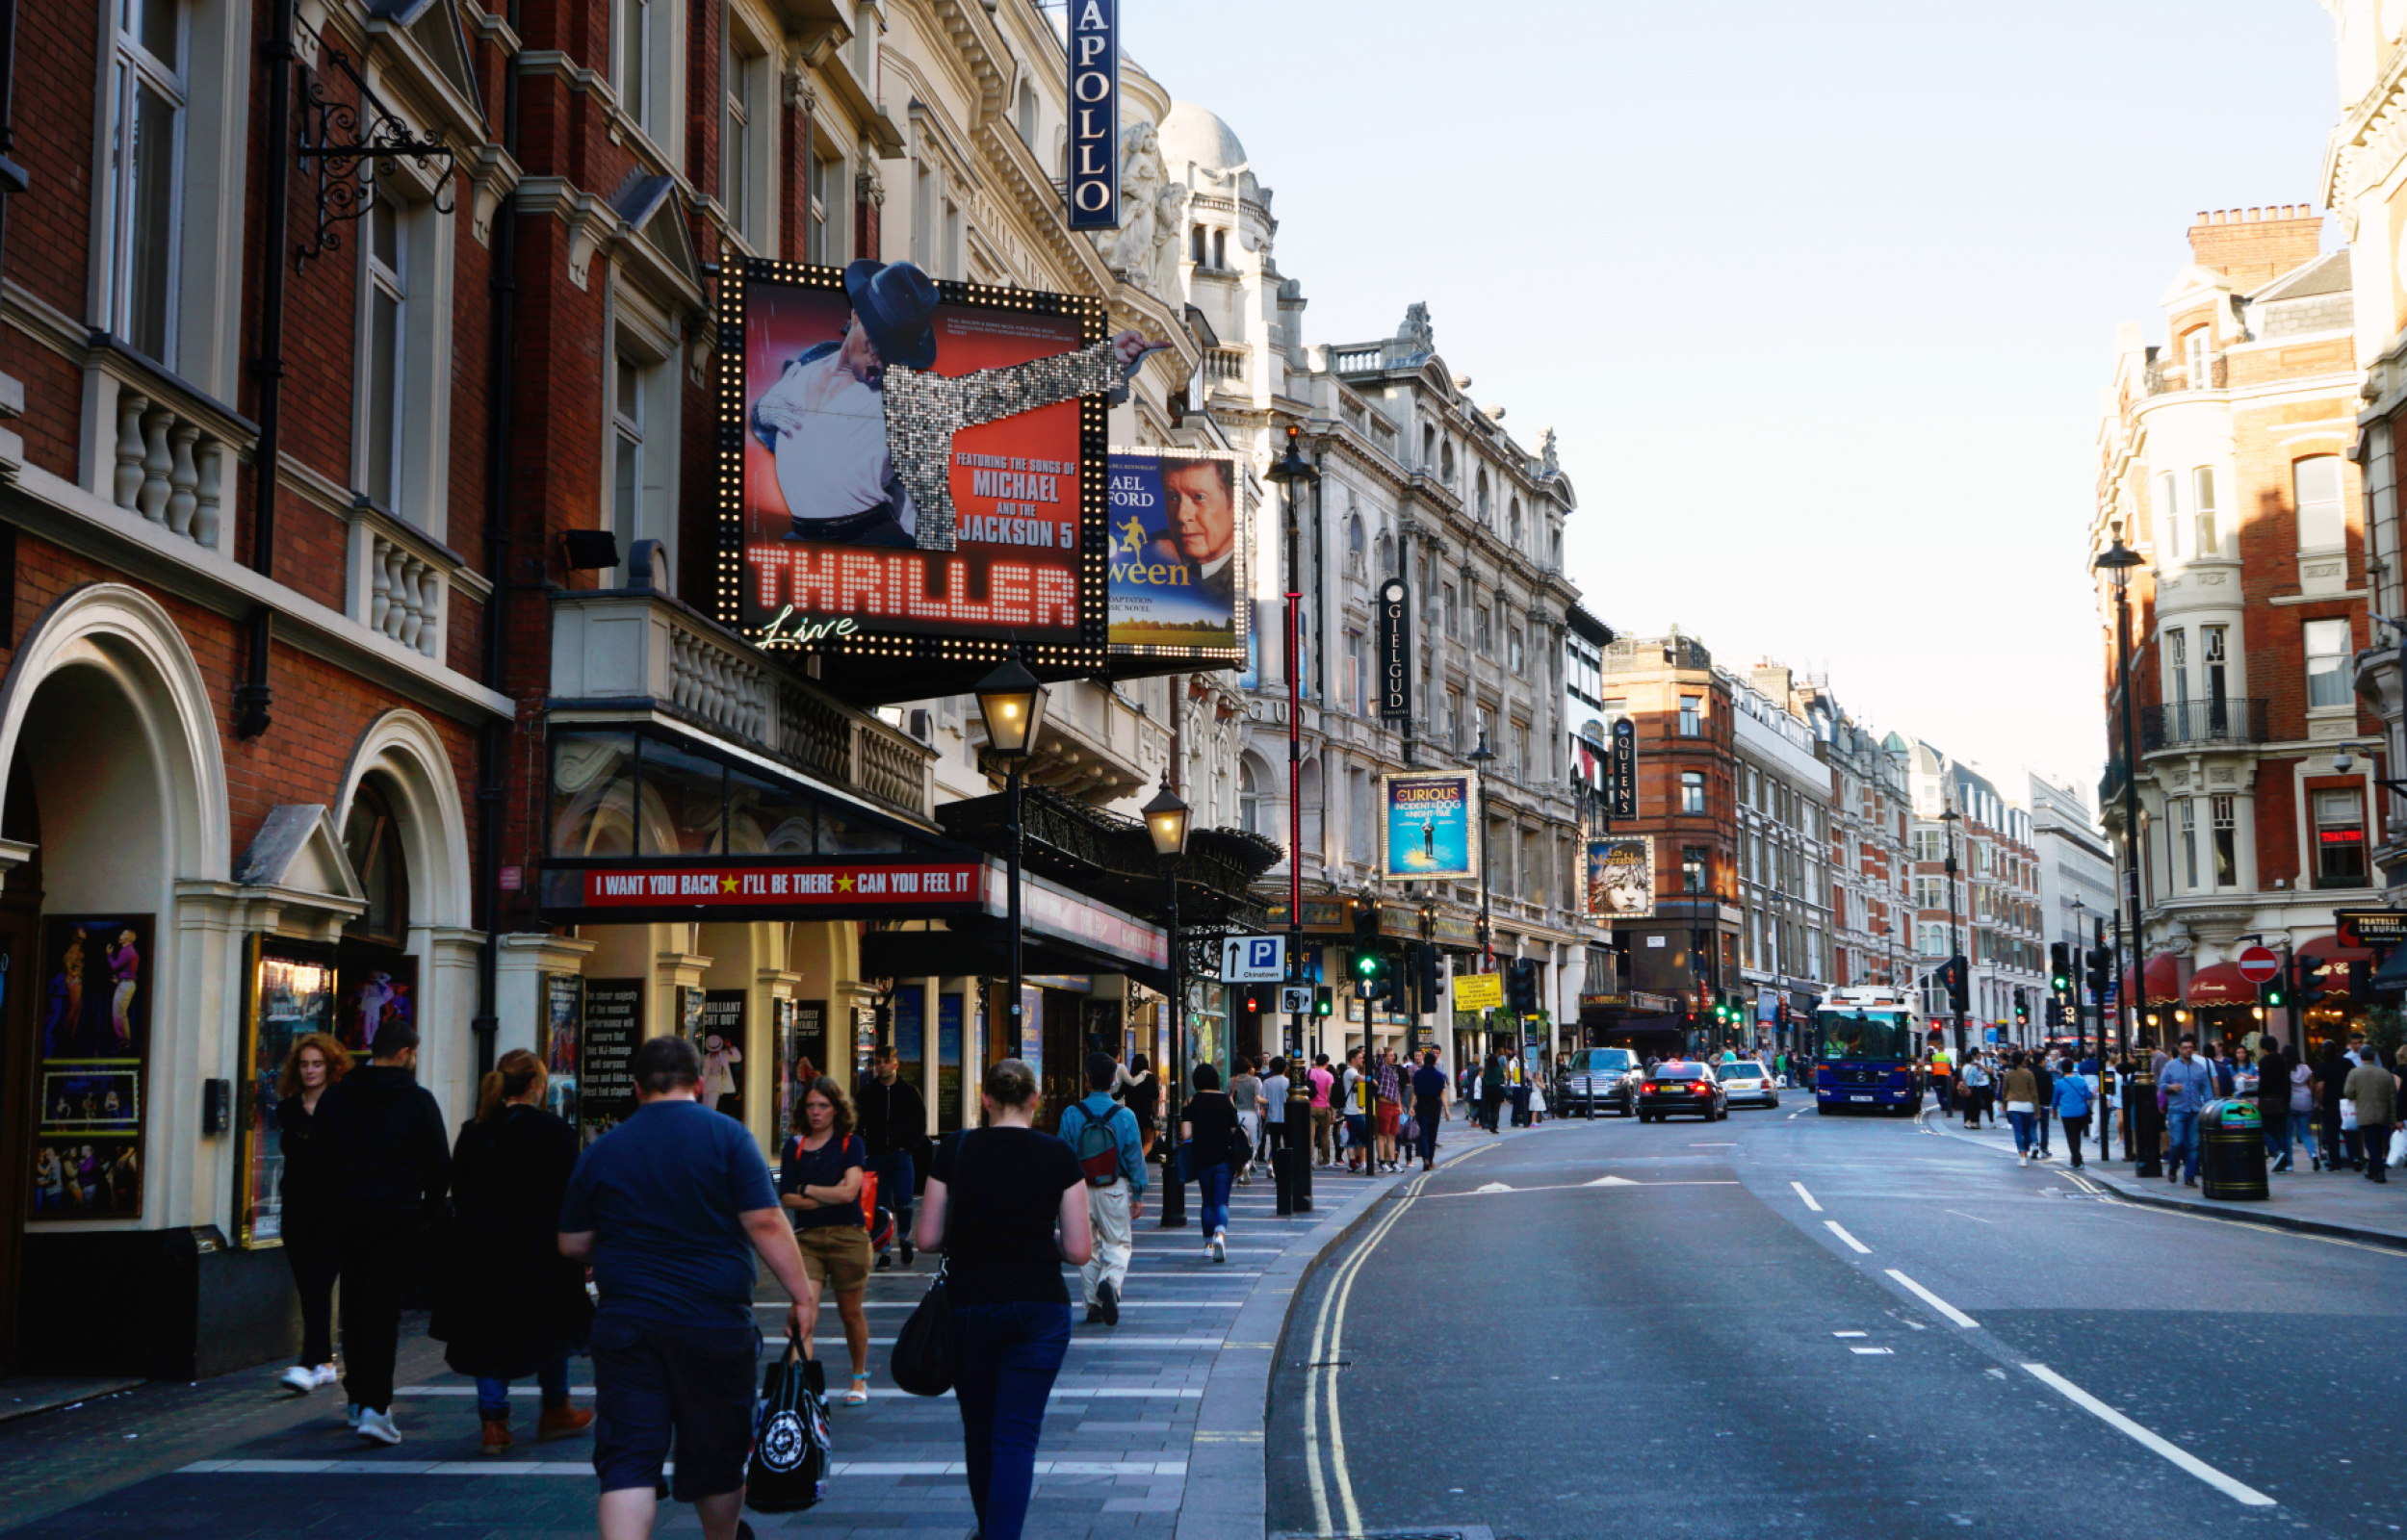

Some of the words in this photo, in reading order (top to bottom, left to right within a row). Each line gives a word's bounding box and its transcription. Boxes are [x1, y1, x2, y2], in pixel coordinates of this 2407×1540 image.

[1075, 0, 1110, 213] APOLLO
[957, 452, 1007, 470] FEATURING
[1010, 457, 1027, 471] THE
[1029, 459, 1061, 474] SONGS
[1064, 461, 1075, 475] OF
[973, 469, 1060, 503] MICHAEL
[1108, 475, 1145, 490] AEL
[996, 501, 1017, 516] AND
[1019, 503, 1036, 518] THE
[957, 514, 1053, 548] JACKSON
[1060, 521, 1074, 549] 5
[749, 547, 1075, 627] THRILLER
[754, 603, 858, 650] Live
[1388, 604, 1403, 707] GIELGUD
[1618, 737, 1631, 813] QUEENS
[1394, 802, 1430, 810] INCIDENT
[1436, 800, 1461, 809] DOG
[1396, 787, 1459, 802] CURIOUS
[1608, 847, 1622, 856] Les
[595, 875, 601, 895] I
[605, 875, 645, 895] WANT
[649, 875, 677, 895] YOU
[681, 875, 719, 895] BACK
[743, 874, 767, 894] I'LL
[771, 874, 788, 894] BE
[793, 874, 834, 893] THERE
[857, 873, 886, 893] CAN
[890, 873, 918, 893] YOU
[923, 872, 951, 893] FEEL
[956, 872, 969, 892] IT
[1255, 942, 1272, 965] P
